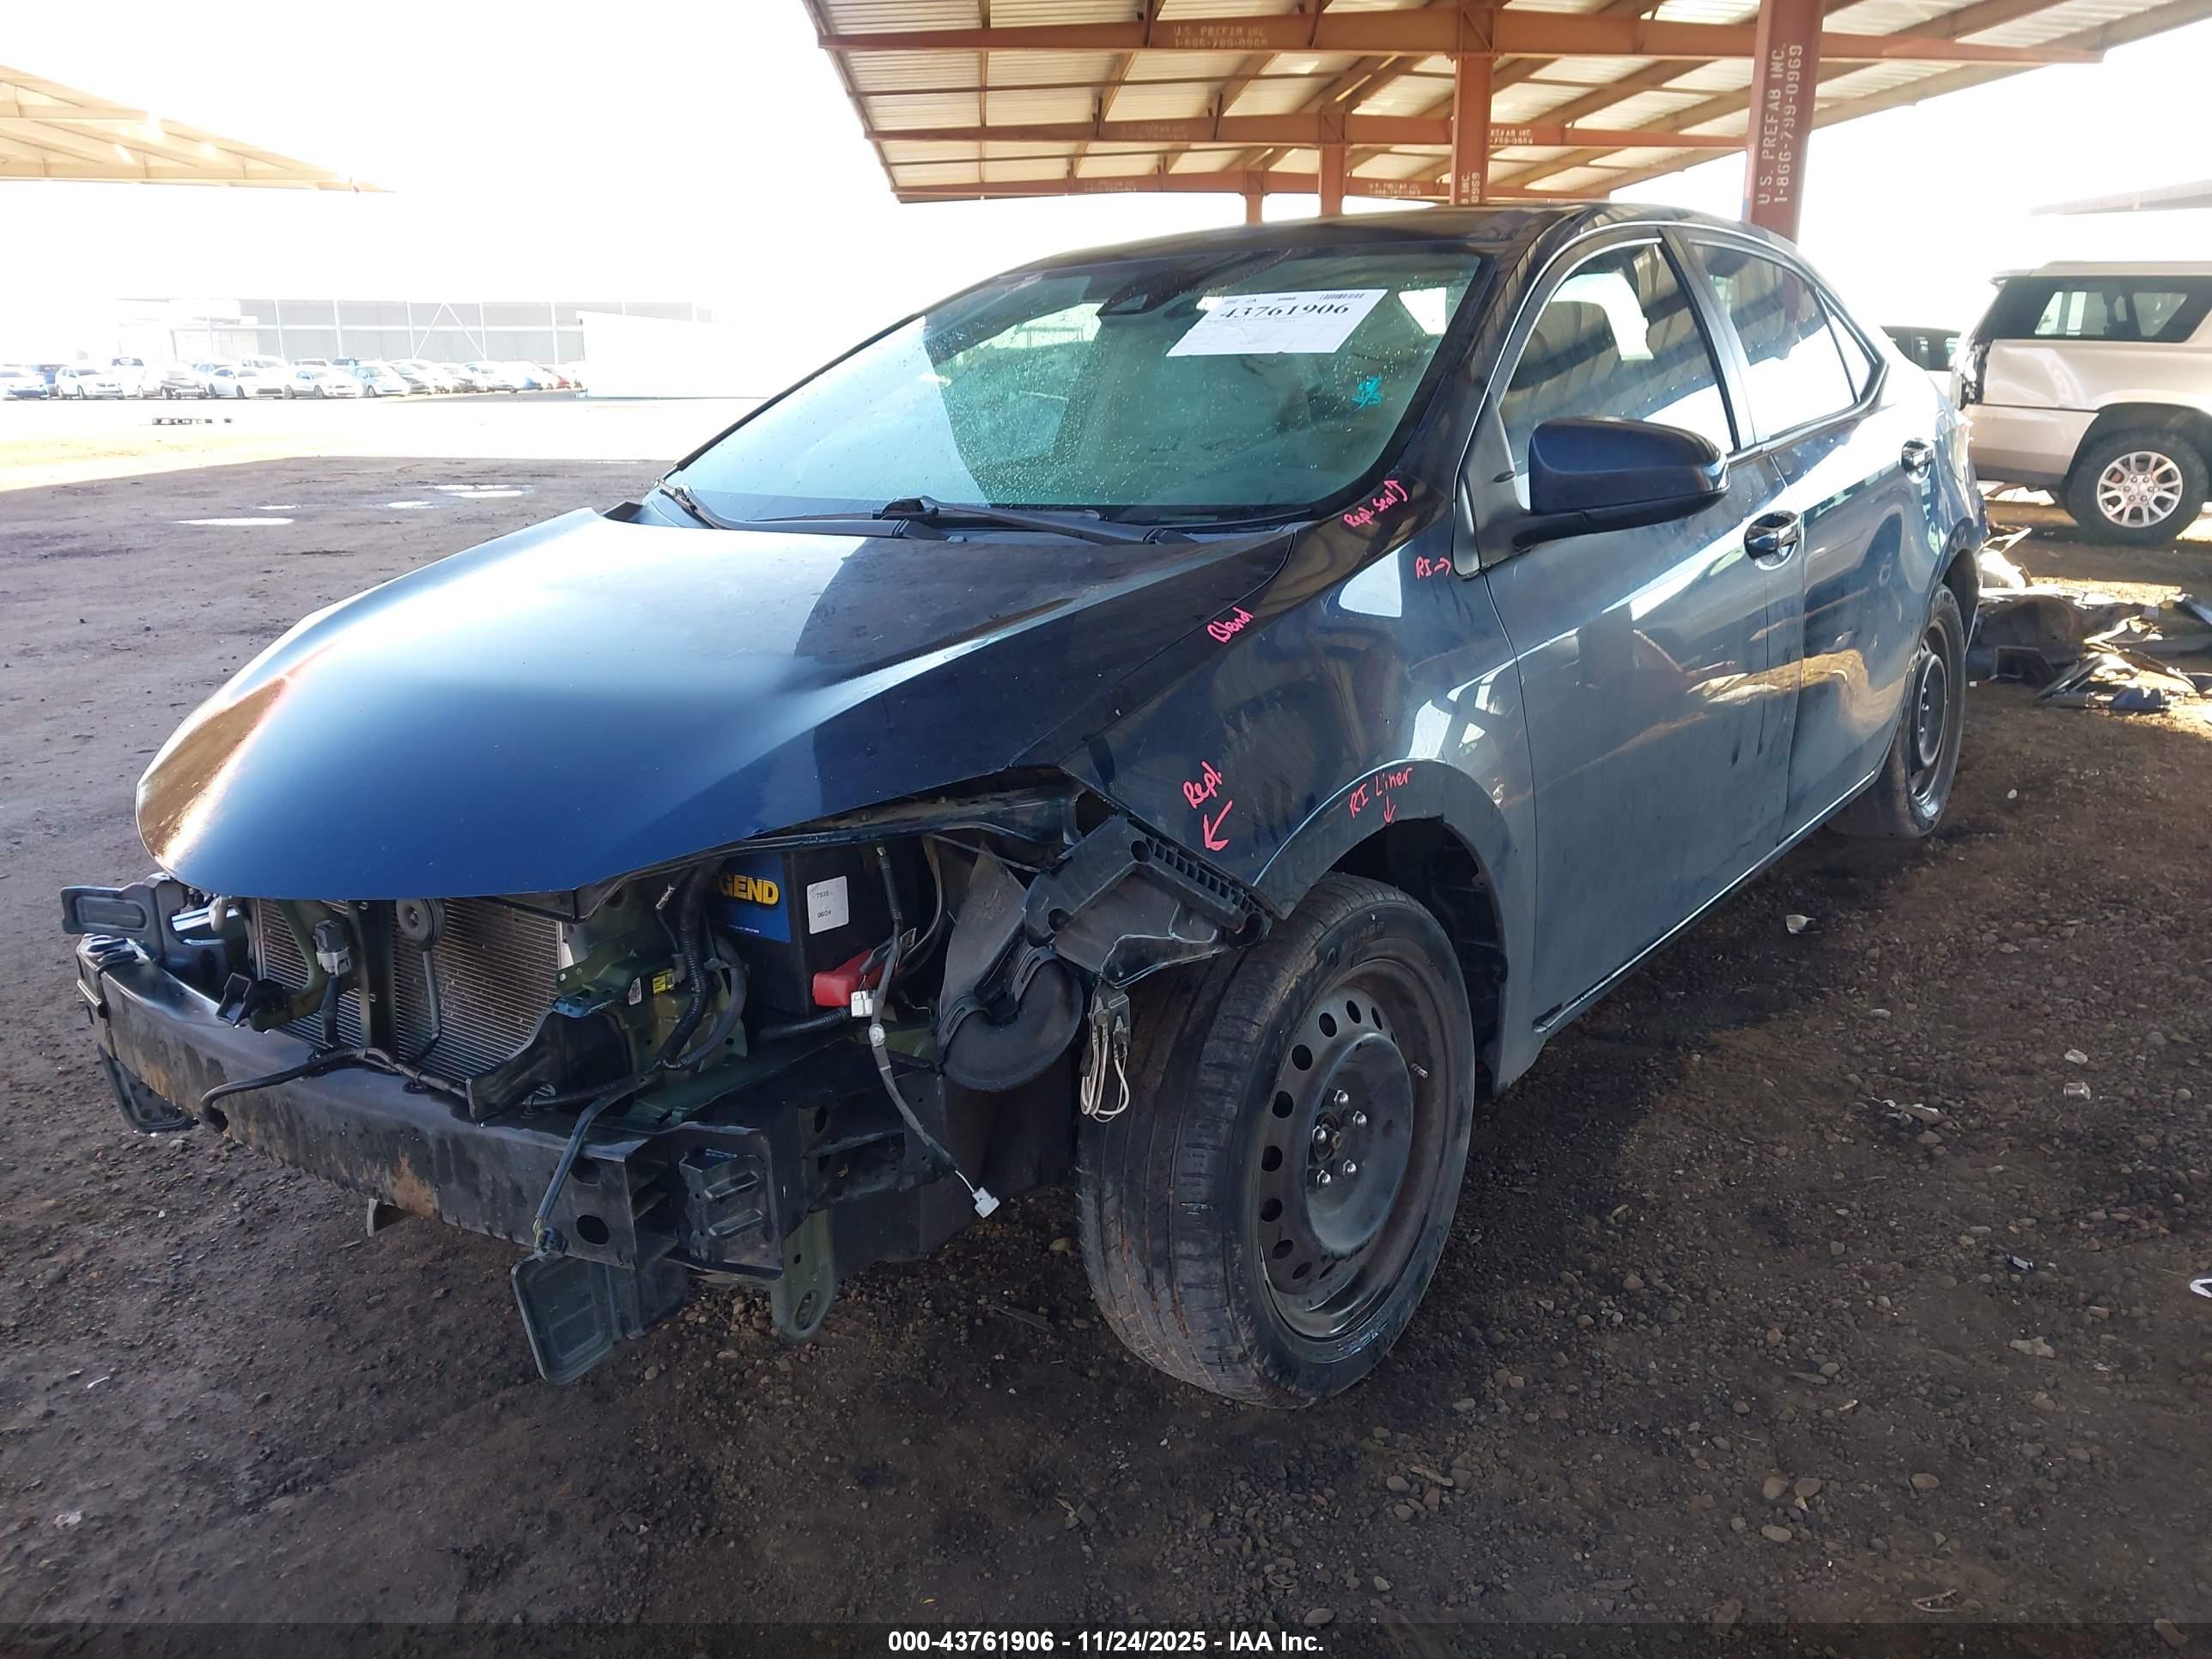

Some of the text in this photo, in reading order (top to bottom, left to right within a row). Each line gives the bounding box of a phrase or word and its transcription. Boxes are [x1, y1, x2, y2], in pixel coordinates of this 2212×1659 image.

[1758, 43, 1787, 204] U.S. PREFAB INC.
[1774, 44, 1803, 203] 1-866-799-0969
[1470, 172, 1481, 204] 0969
[1219, 303, 1352, 319] 43761906
[1375, 767, 1413, 797] Liner
